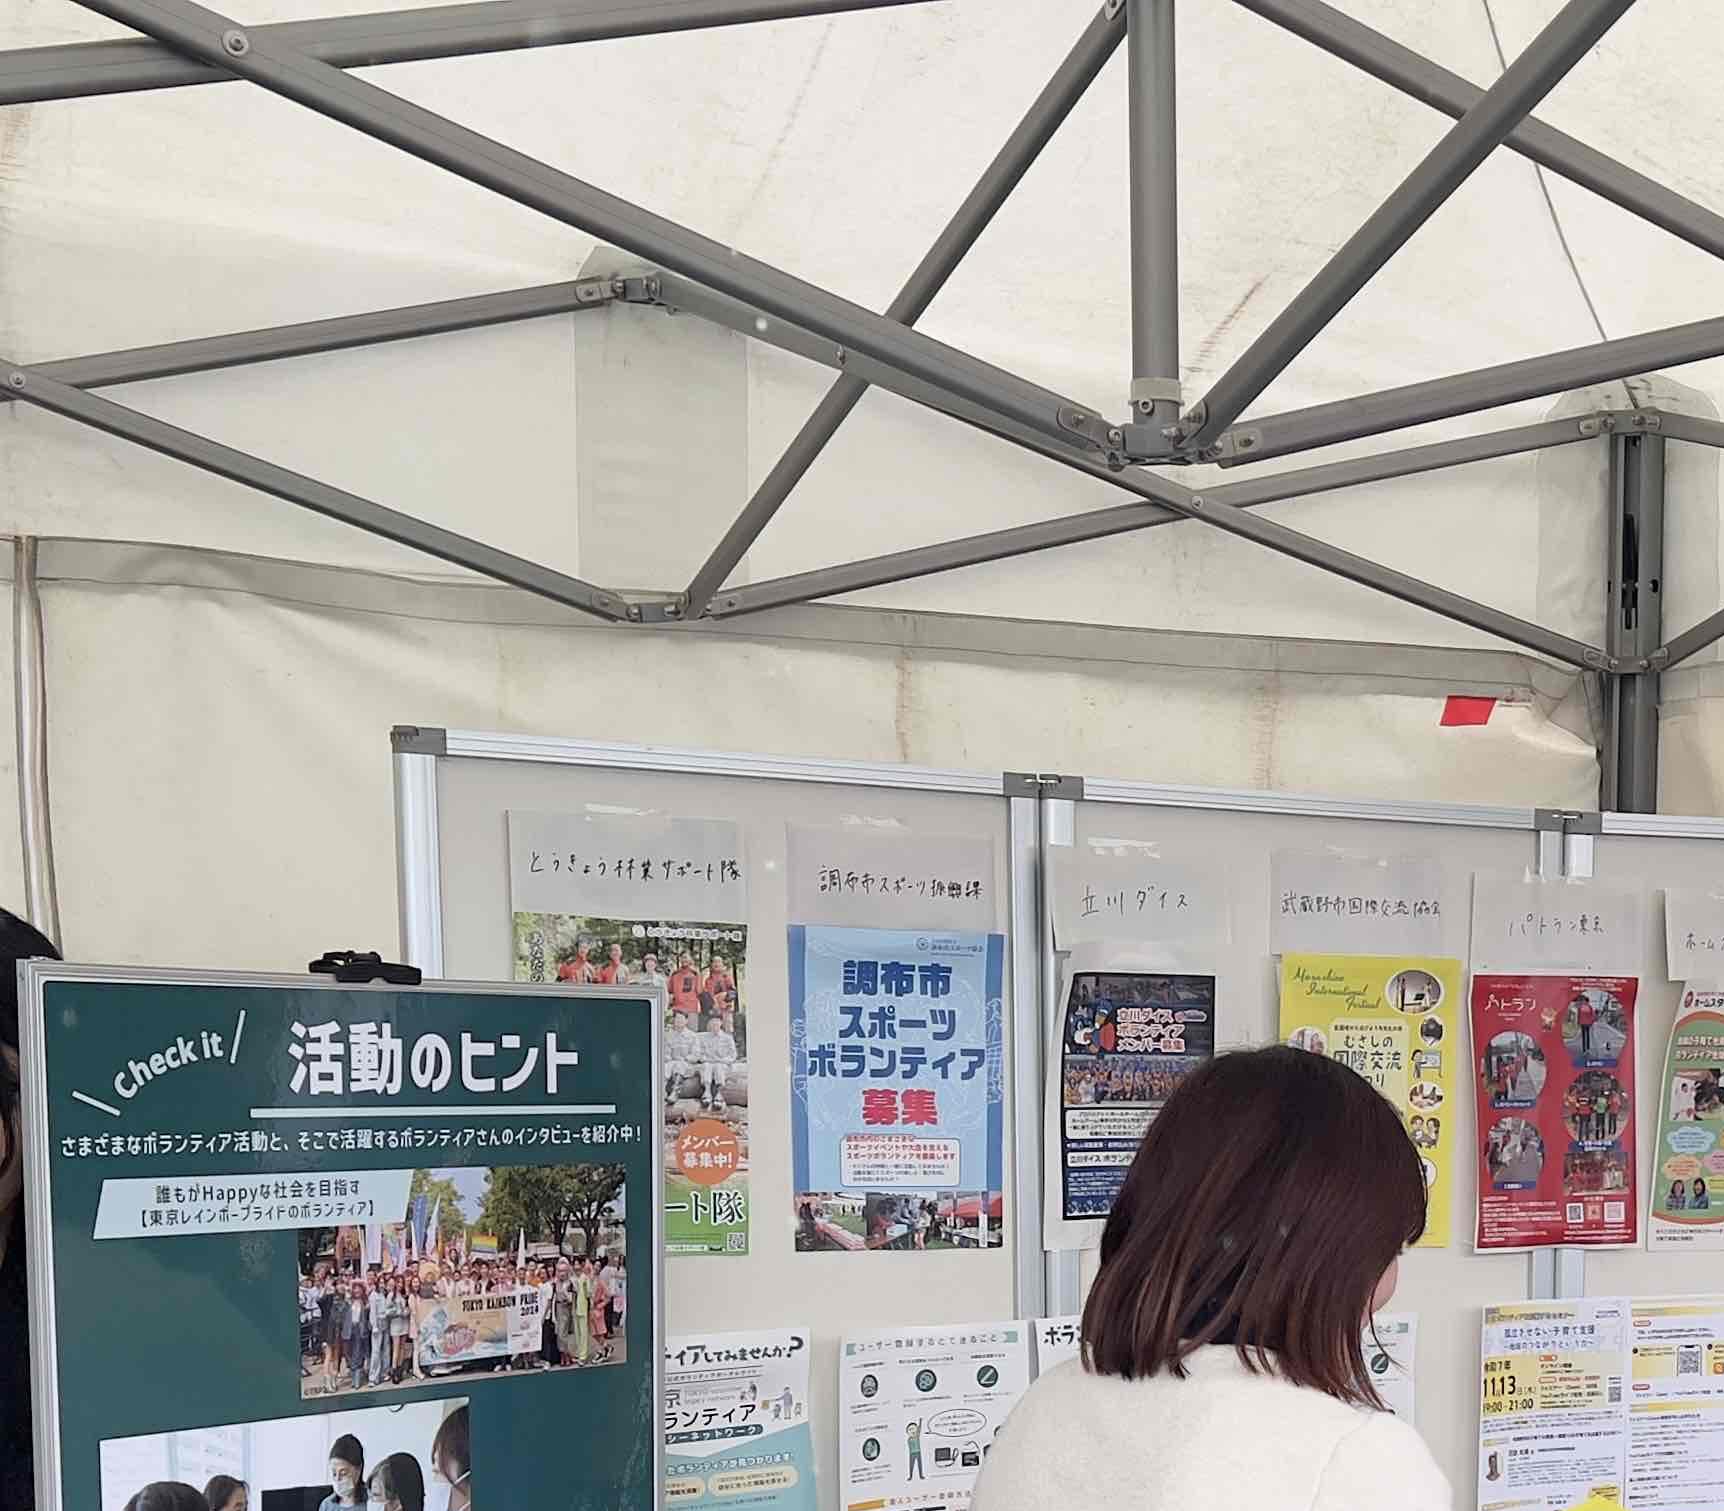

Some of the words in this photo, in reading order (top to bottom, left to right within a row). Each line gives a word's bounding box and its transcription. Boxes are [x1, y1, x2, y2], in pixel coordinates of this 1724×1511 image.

[1081, 884, 1189, 919] 立川ダイス
[842, 959, 953, 998] 調布市
[838, 1005, 957, 1042] スポーツ
[1343, 1034, 1393, 1049] むさしの
[287, 1020, 579, 1096] 活動のヒント
[807, 1044, 987, 1083] ボランティア
[861, 1088, 940, 1128] 募集
[681, 1135, 735, 1150] メンバー
[155, 1179, 360, 1204] 誰もがHappyな社会を目指す
[858, 1333, 998, 1352] ユーザー登録するとできること
